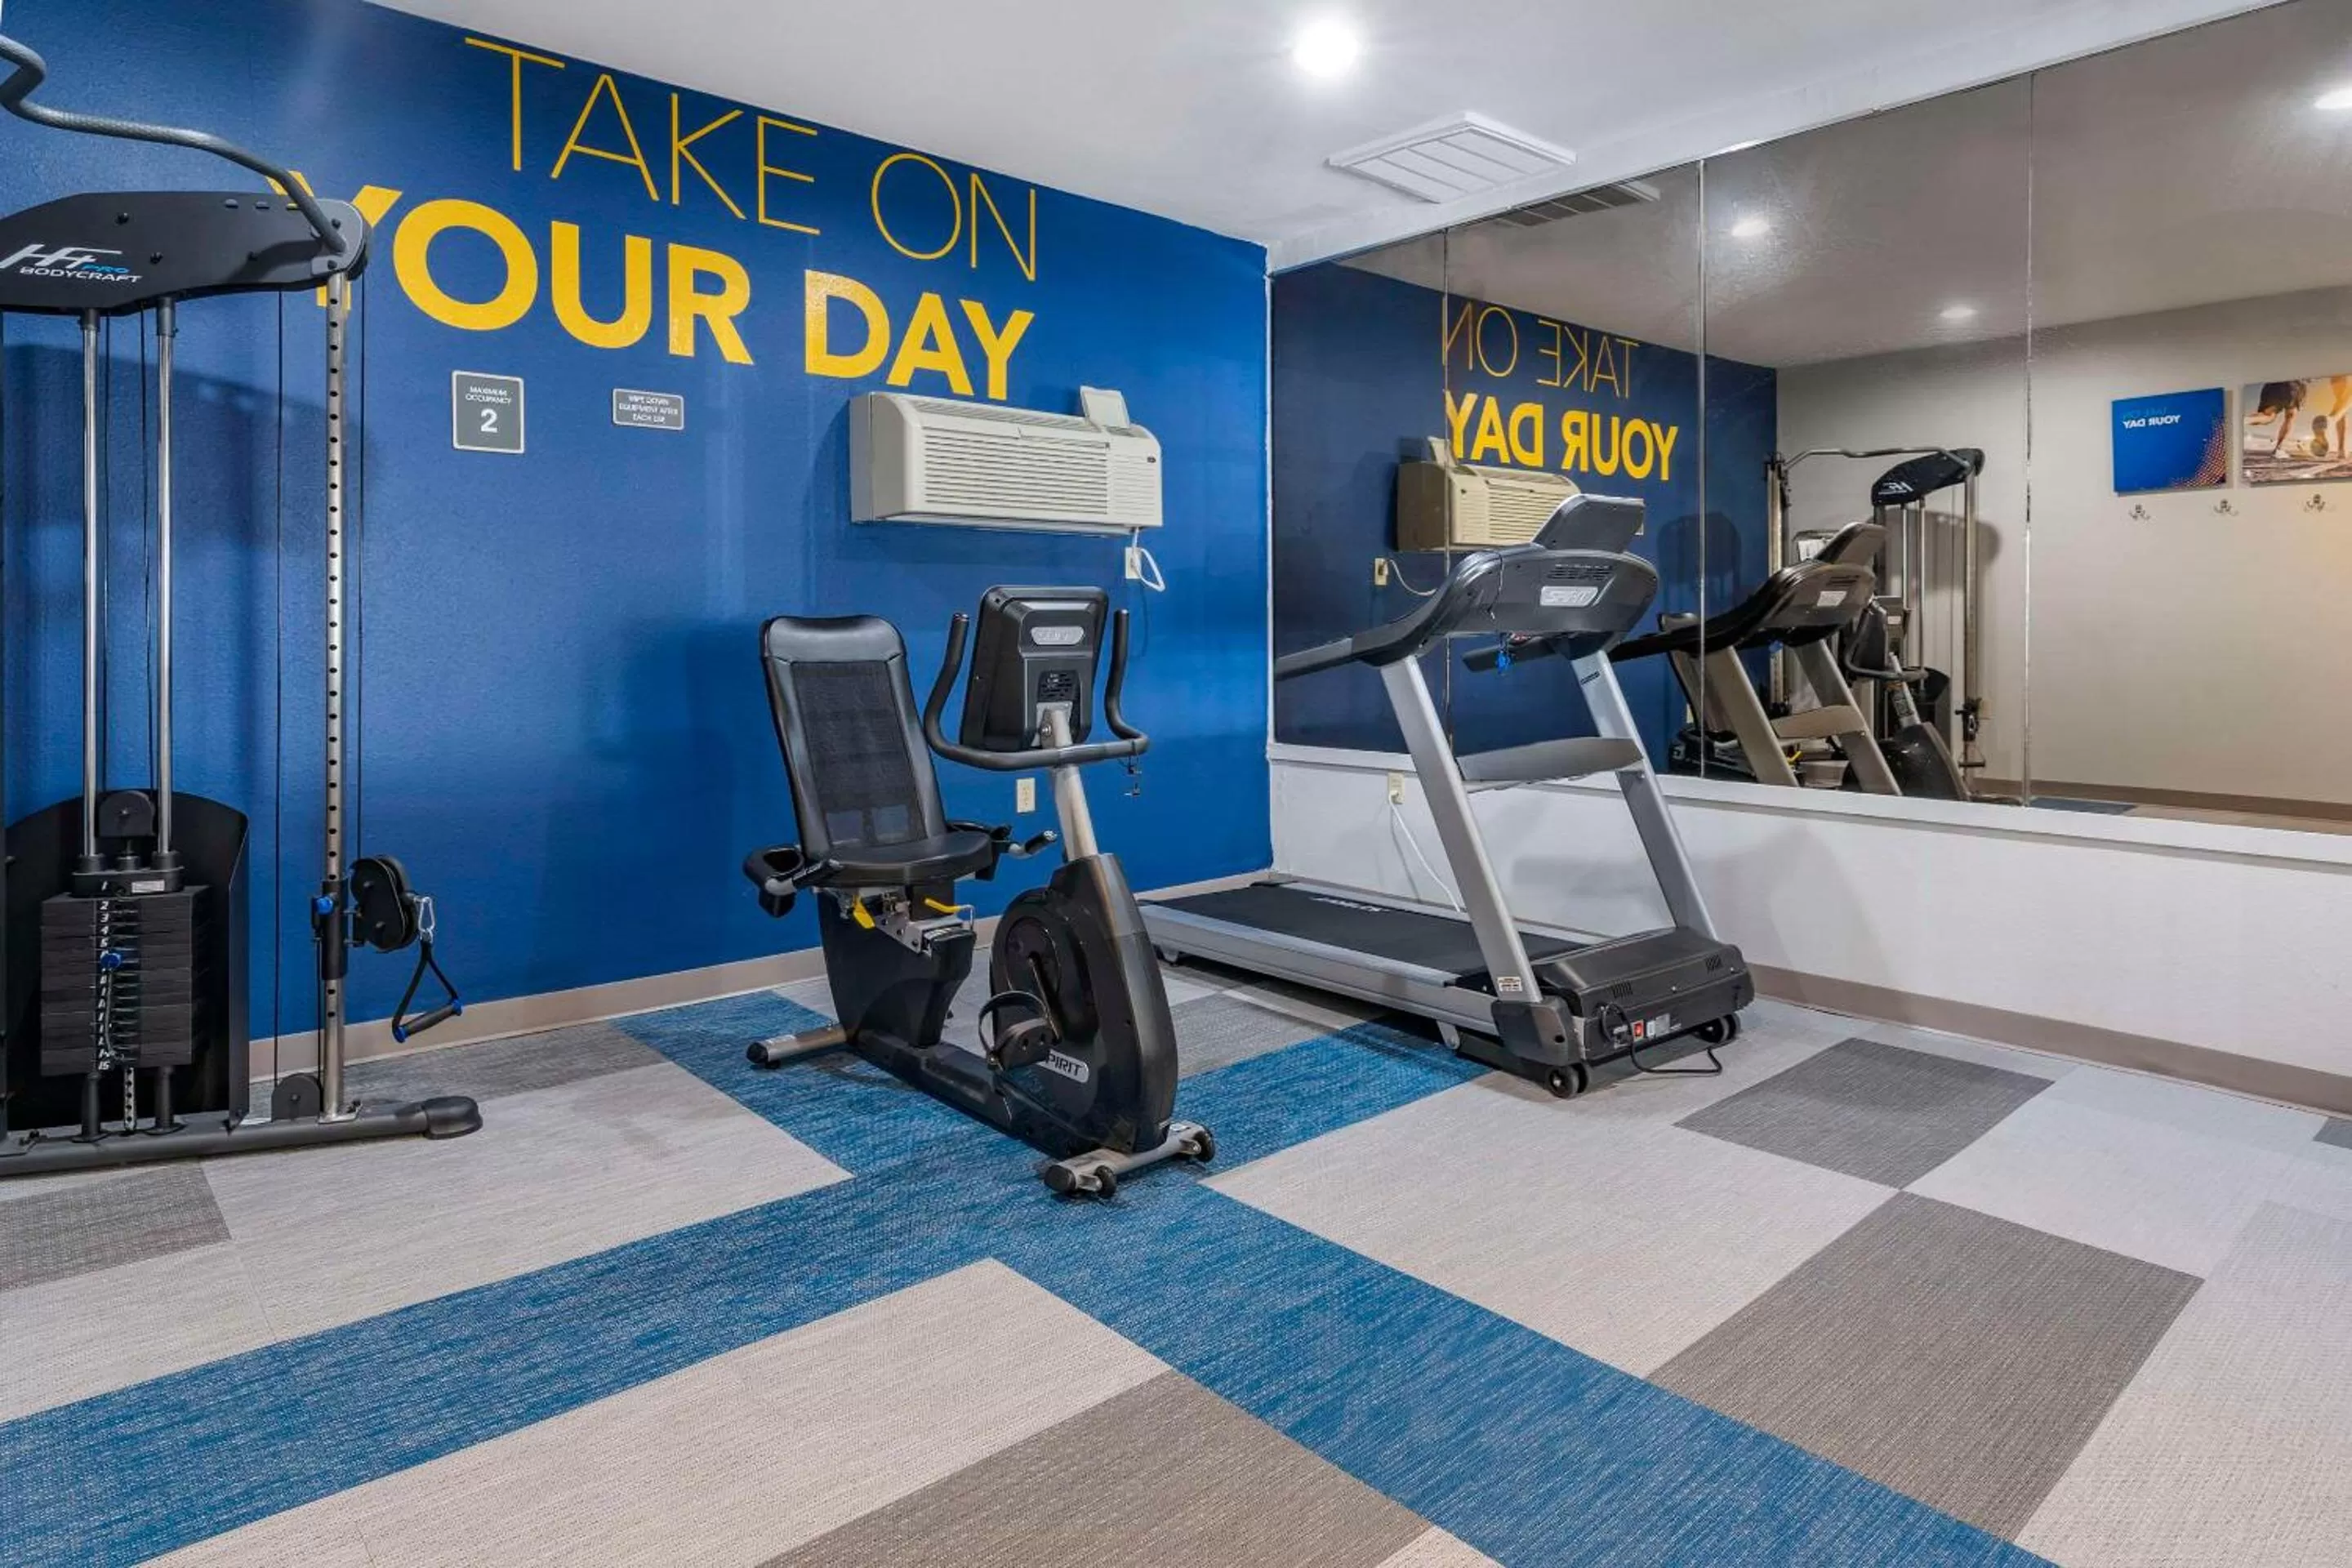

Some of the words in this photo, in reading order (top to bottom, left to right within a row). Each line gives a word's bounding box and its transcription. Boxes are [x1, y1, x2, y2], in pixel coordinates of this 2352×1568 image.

[465, 37, 821, 236] TAKE
[871, 152, 1036, 282] ON
[20, 266, 142, 283] BODYCRAFT
[804, 268, 1036, 401] DAY
[480, 408, 497, 434] 2
[100, 901, 109, 910] 2
[100, 913, 109, 923] 3
[1046, 1052, 1083, 1076] PIRIT
